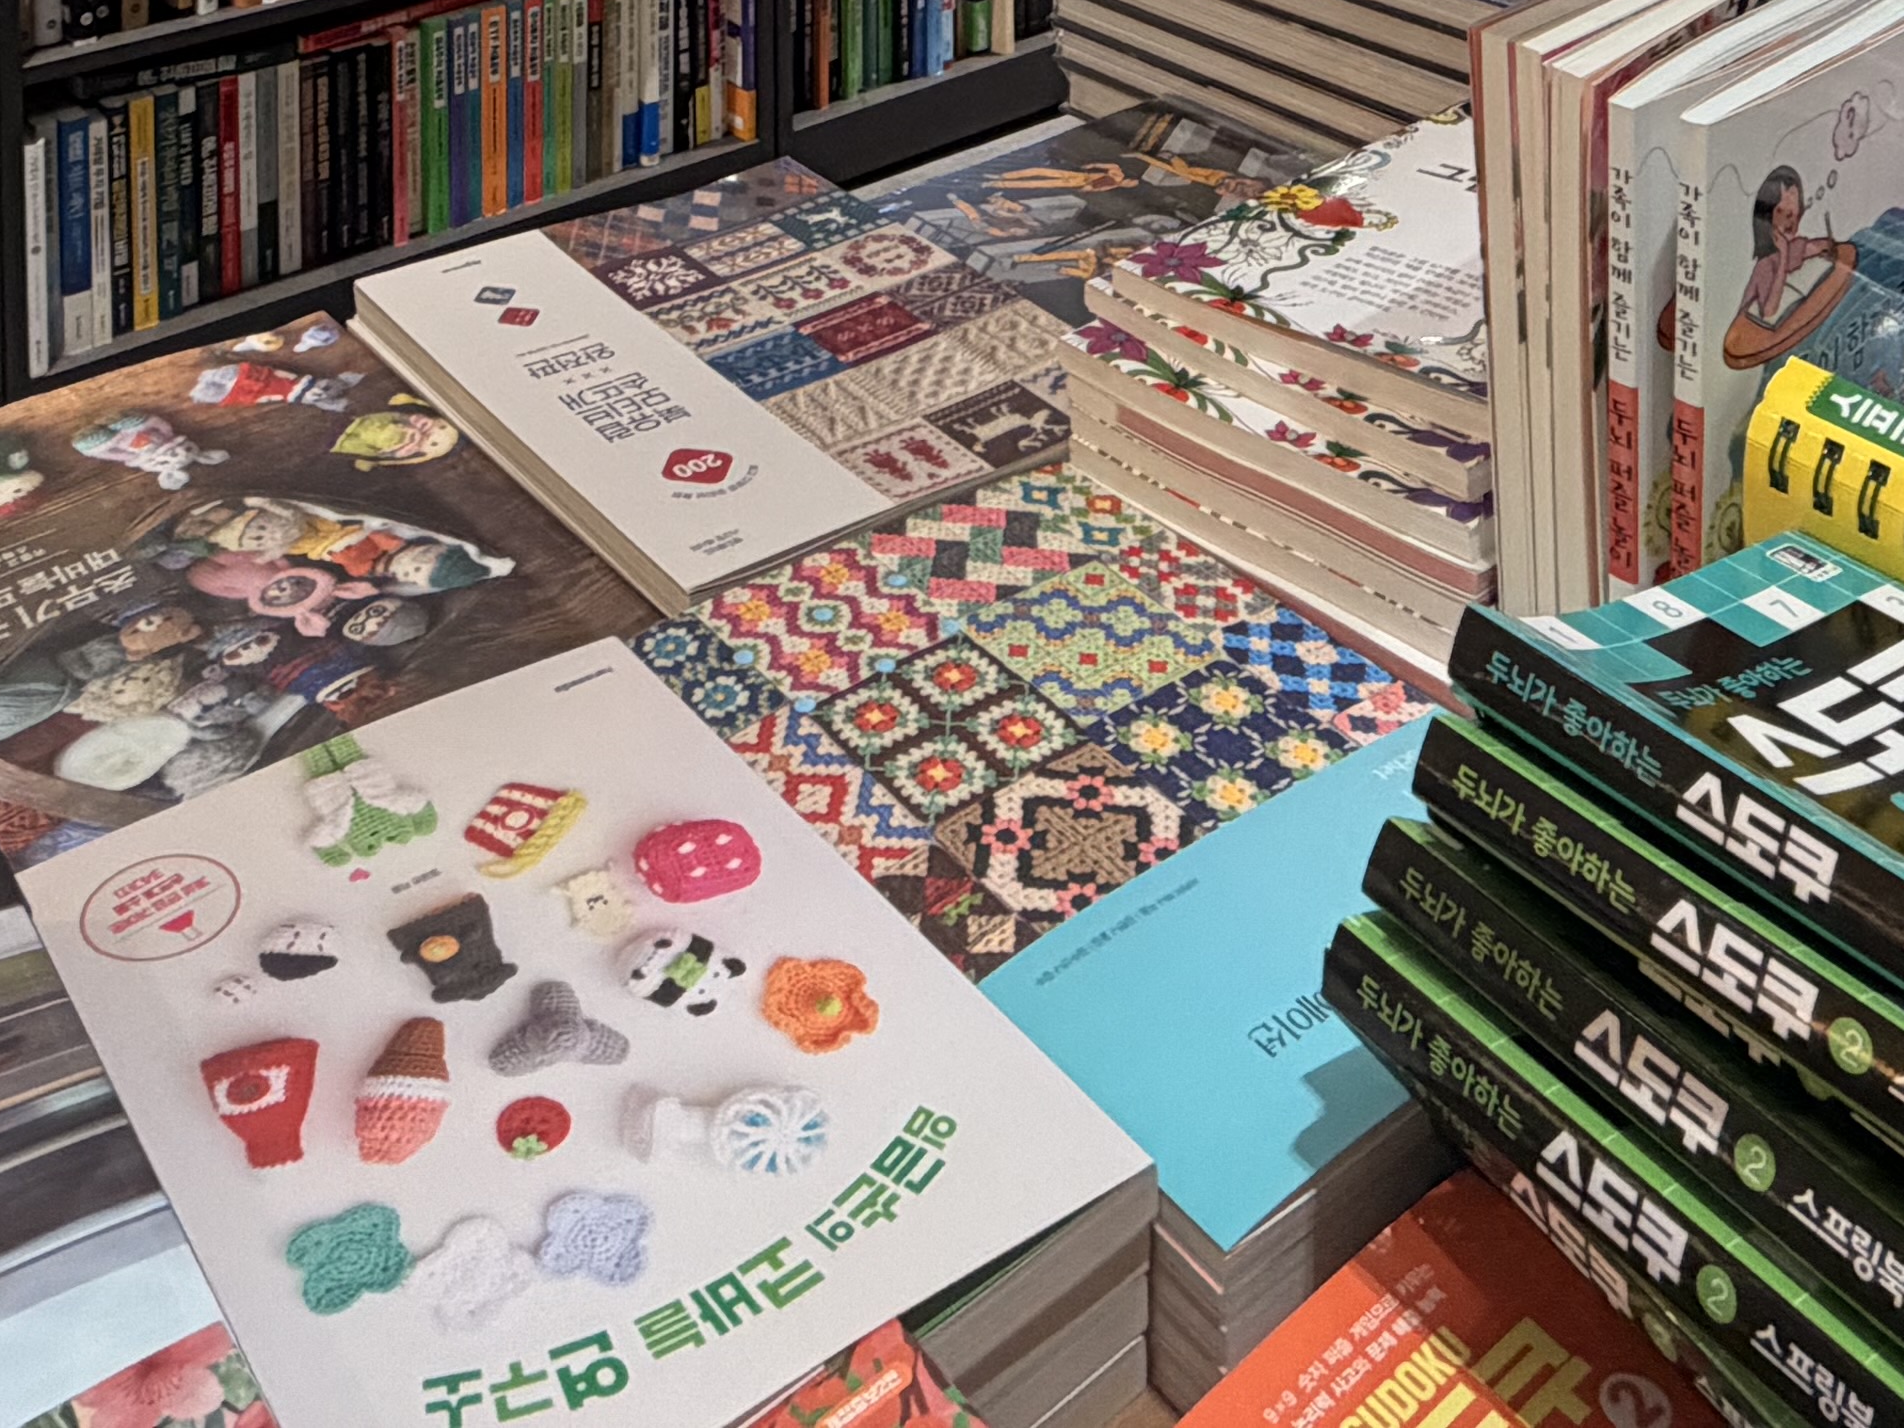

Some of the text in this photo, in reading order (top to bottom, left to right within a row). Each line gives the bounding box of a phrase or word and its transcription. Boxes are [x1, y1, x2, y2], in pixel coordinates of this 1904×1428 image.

[523, 342, 616, 380] 완전판
[558, 371, 649, 413] 손뜨개
[574, 386, 672, 422] 모티브
[1607, 168, 1637, 574] 가족이 함께 즐기는 두뇌 퍼즐 놀이
[1670, 180, 1704, 530] 가족이 함께 즐기는 두뇌 퍼즐
[672, 452, 724, 479] 200
[16, 546, 123, 596] 대바늘
[1487, 650, 1556, 716] 두뇌가
[1562, 696, 1663, 790] 좋아하는
[1675, 770, 1841, 906] 스도쿠
[1451, 762, 1527, 836] 두뇌가
[1531, 815, 1639, 917] 좋아하는
[1650, 897, 1821, 1043] 스도쿠
[1399, 866, 1467, 939] 두뇌가
[1470, 922, 1565, 1023] 좋아하는
[1574, 1008, 1731, 1156] 스도쿠
[1356, 973, 1424, 1049] 두뇌가
[1428, 1034, 1524, 1141] 좋아하는
[1536, 1128, 1691, 1286] 스도쿠
[1749, 1318, 1878, 1428] 스프링북
[633, 1235, 826, 1361] 코바늘
[422, 1330, 631, 1428] 연구소
